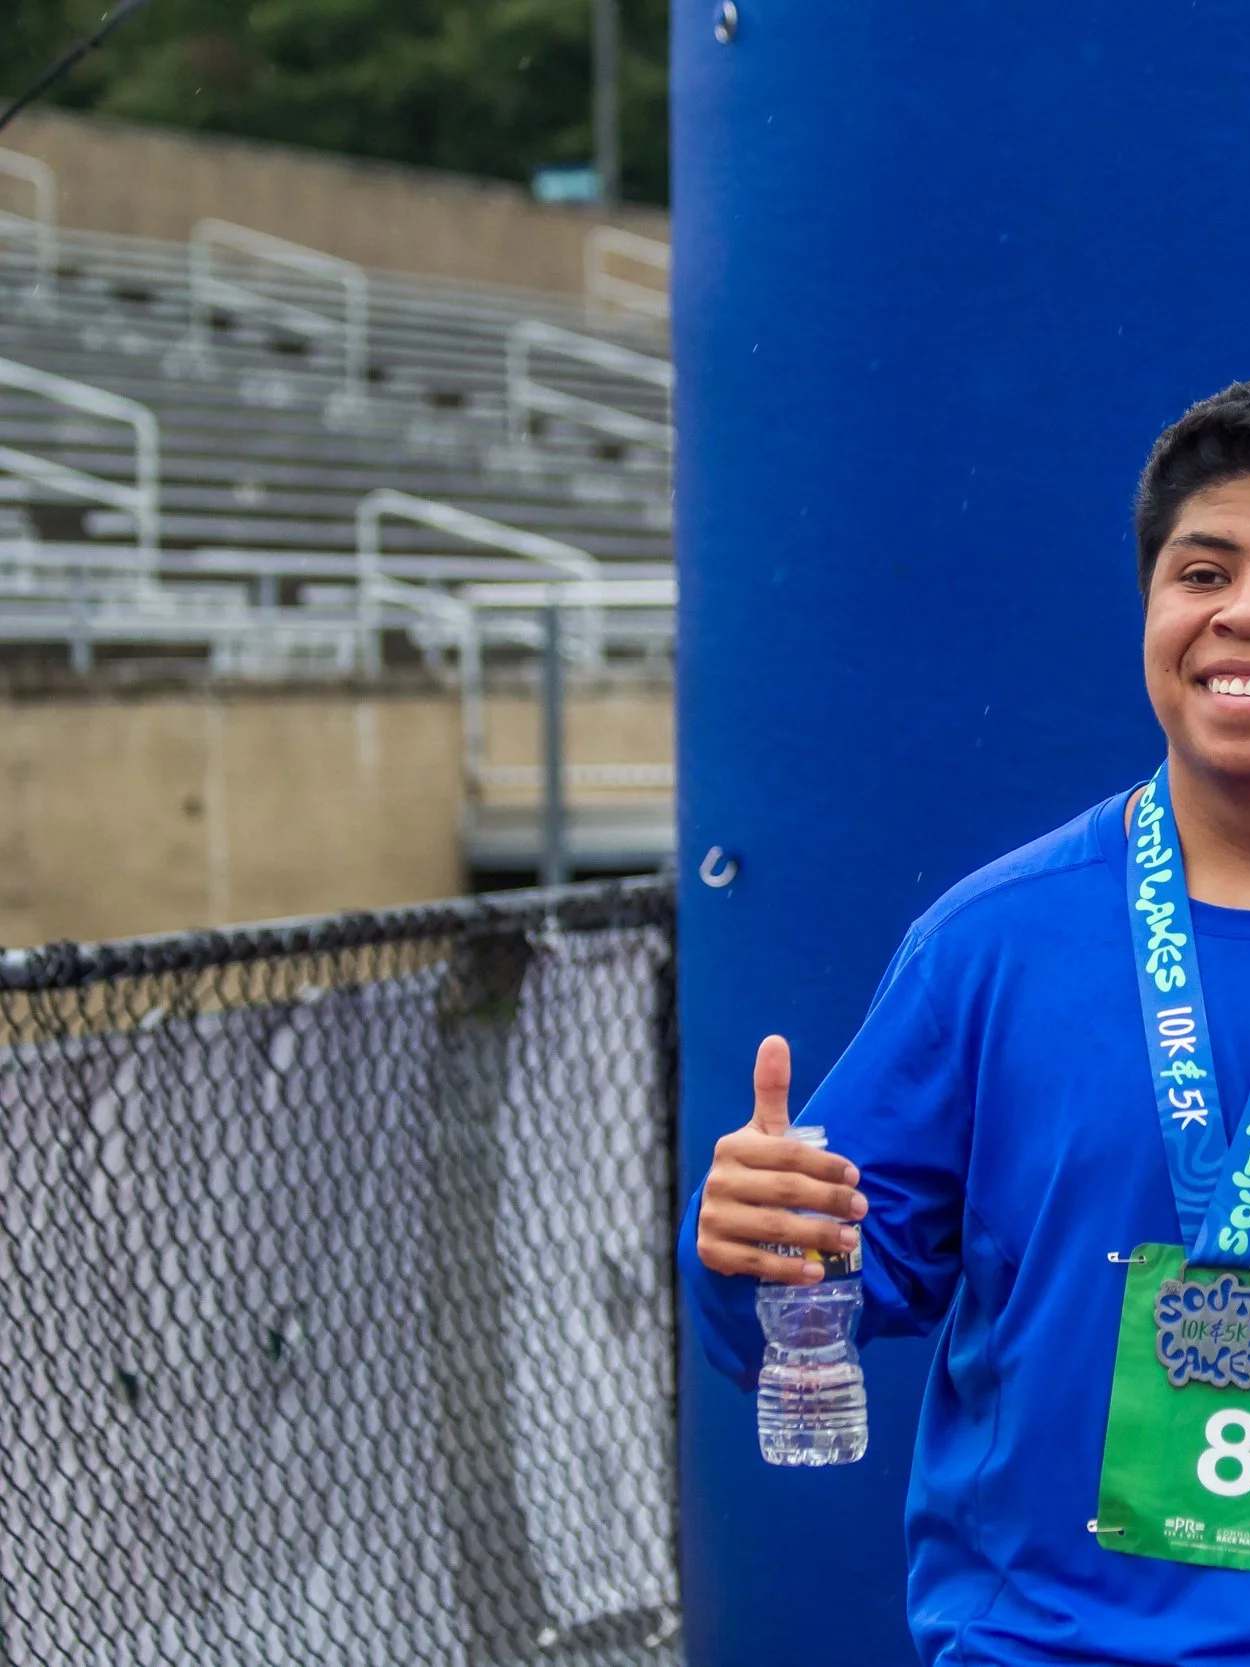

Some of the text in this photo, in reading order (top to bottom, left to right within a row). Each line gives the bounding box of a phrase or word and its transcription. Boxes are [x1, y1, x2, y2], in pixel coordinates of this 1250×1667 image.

[1136, 765, 1208, 1129] OUTH LAKES 10K & 5K
[1181, 1318, 1249, 1344] 10K & 5K
[1216, 1535, 1237, 1545] RACE
